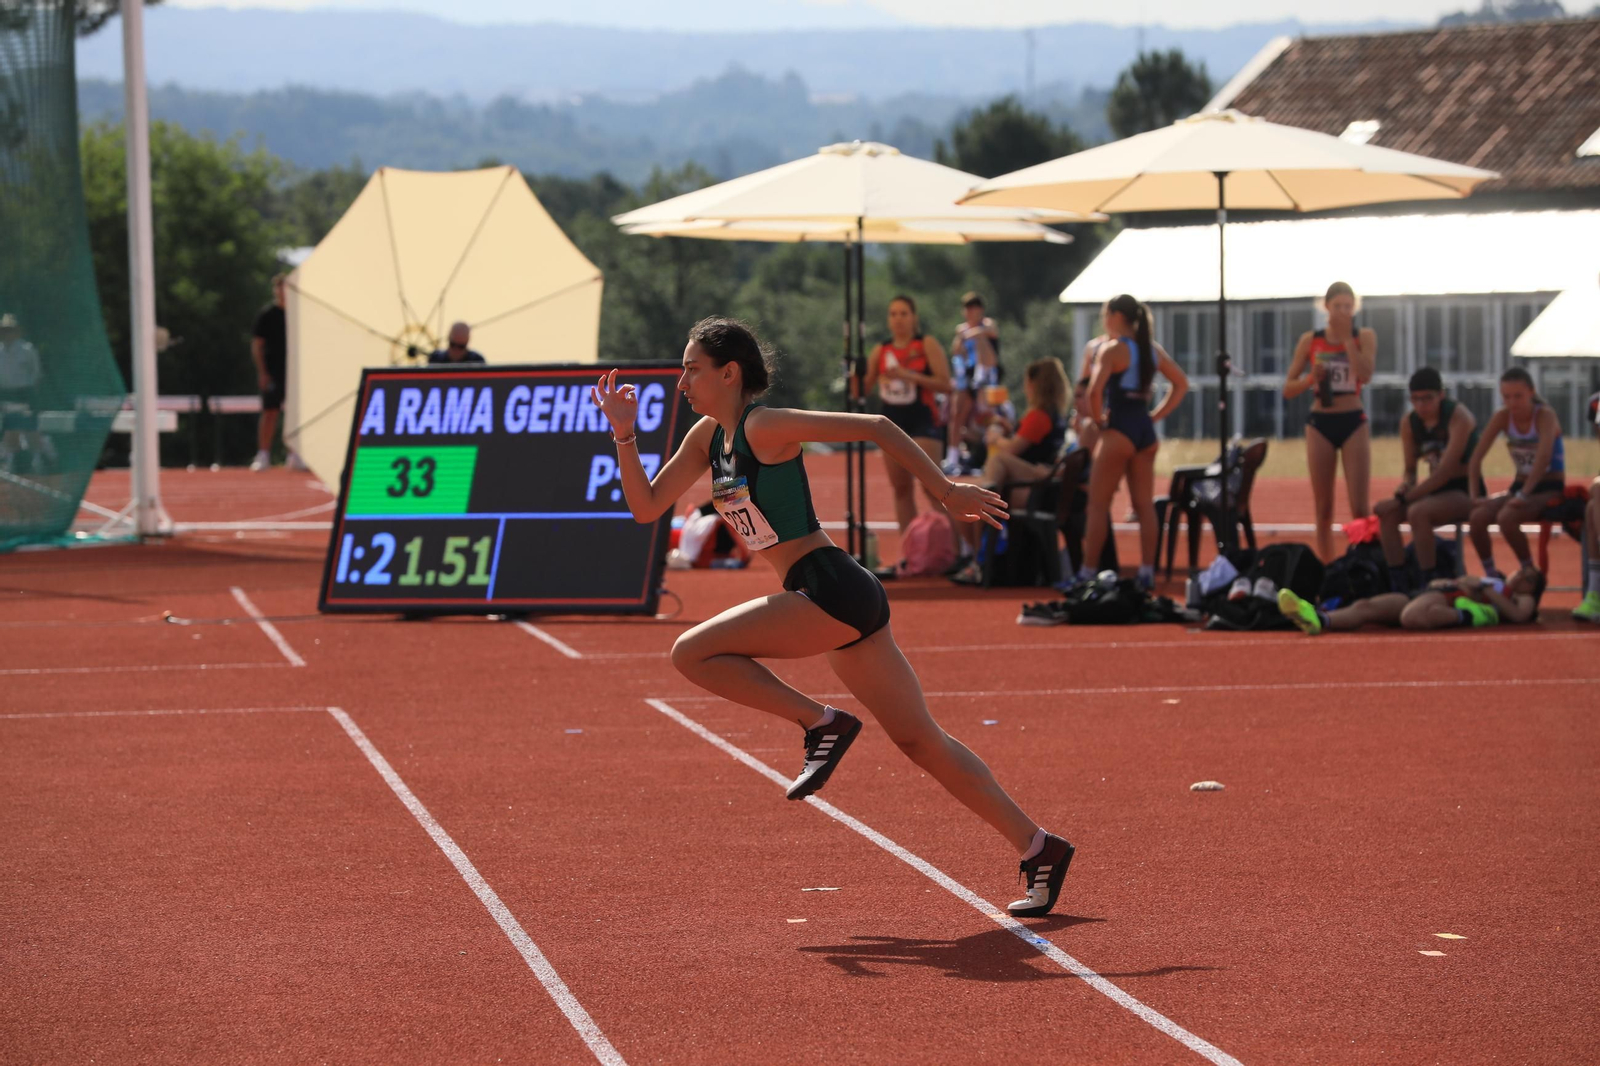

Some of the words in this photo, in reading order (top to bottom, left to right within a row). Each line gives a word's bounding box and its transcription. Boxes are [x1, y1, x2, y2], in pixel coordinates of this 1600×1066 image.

[1329, 366, 1350, 383] 61
[360, 388, 385, 435] A
[394, 387, 493, 434] RAMA
[504, 383, 665, 433] GEHRG
[387, 456, 437, 498] 33
[398, 536, 492, 586] 1.51
